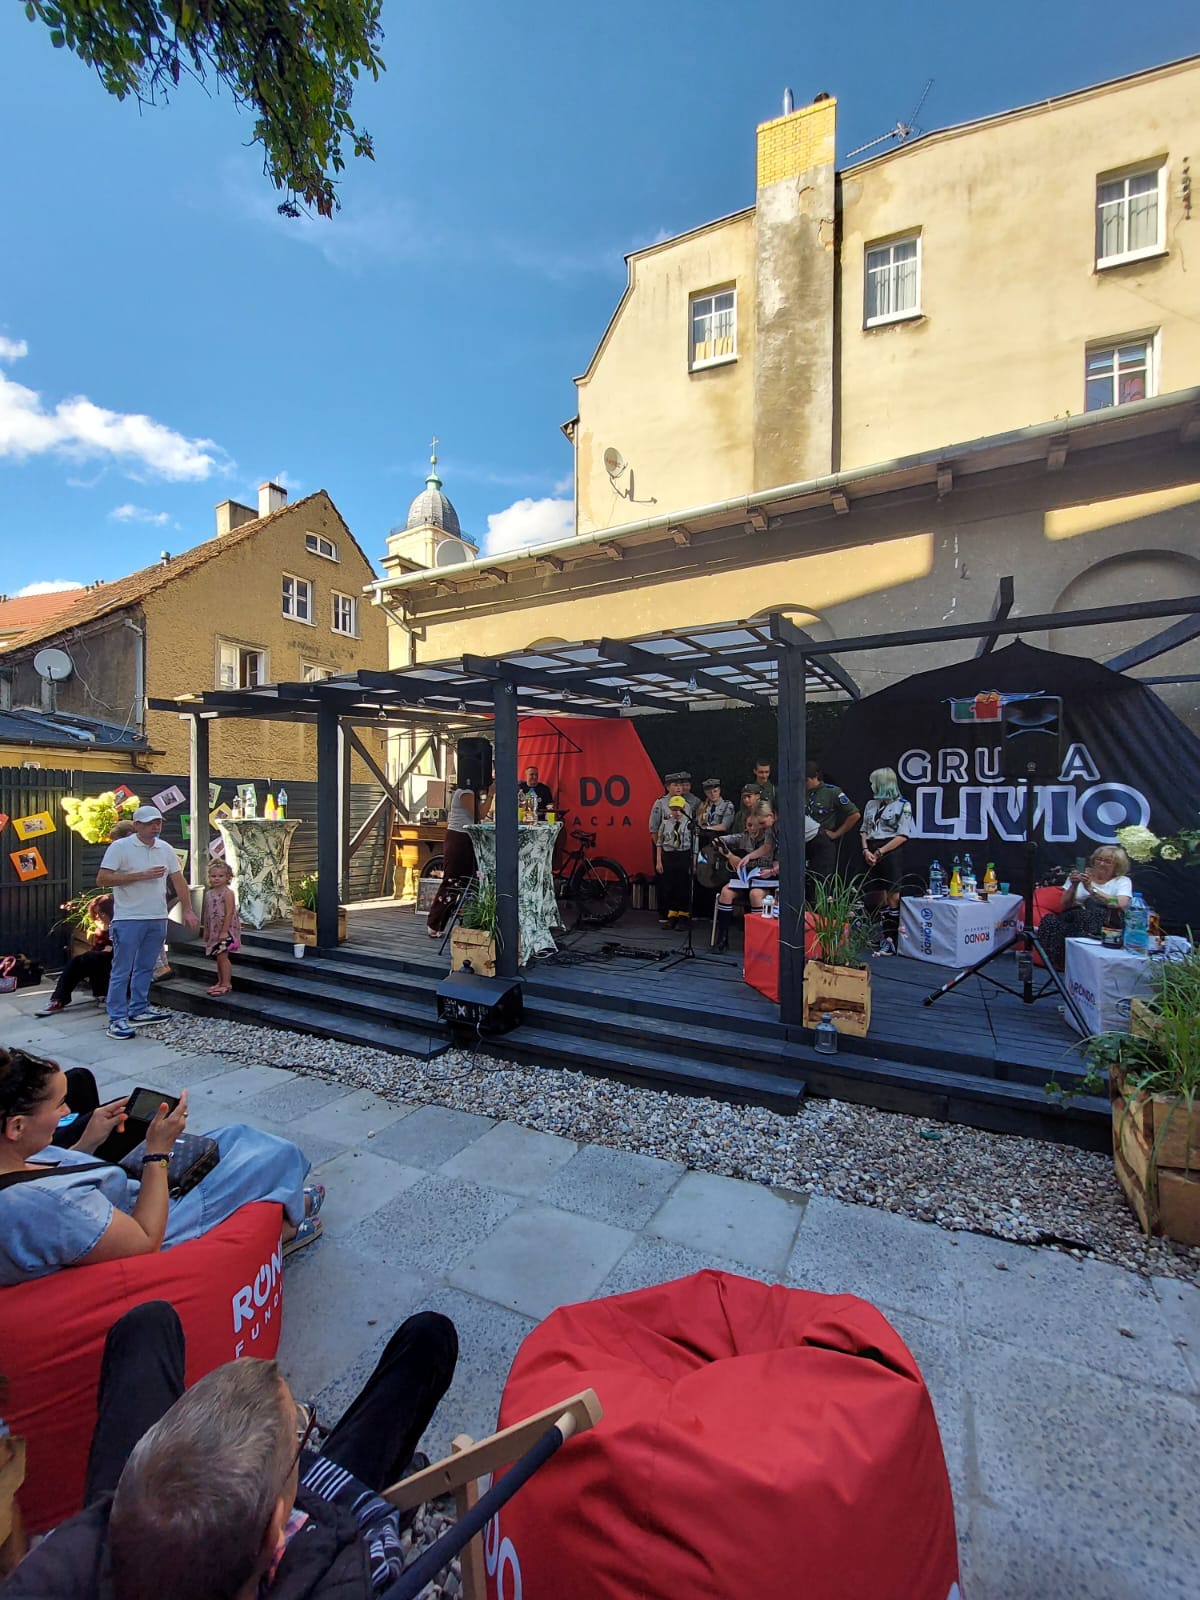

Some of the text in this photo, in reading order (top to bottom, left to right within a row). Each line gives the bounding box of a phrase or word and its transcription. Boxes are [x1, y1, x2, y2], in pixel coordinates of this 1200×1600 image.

[898, 743, 1100, 784] GRUA
[924, 921, 933, 955] RONDO
[964, 932, 990, 945] RONDO
[232, 1232, 283, 1334] RON
[235, 1281, 282, 1359] FUND
